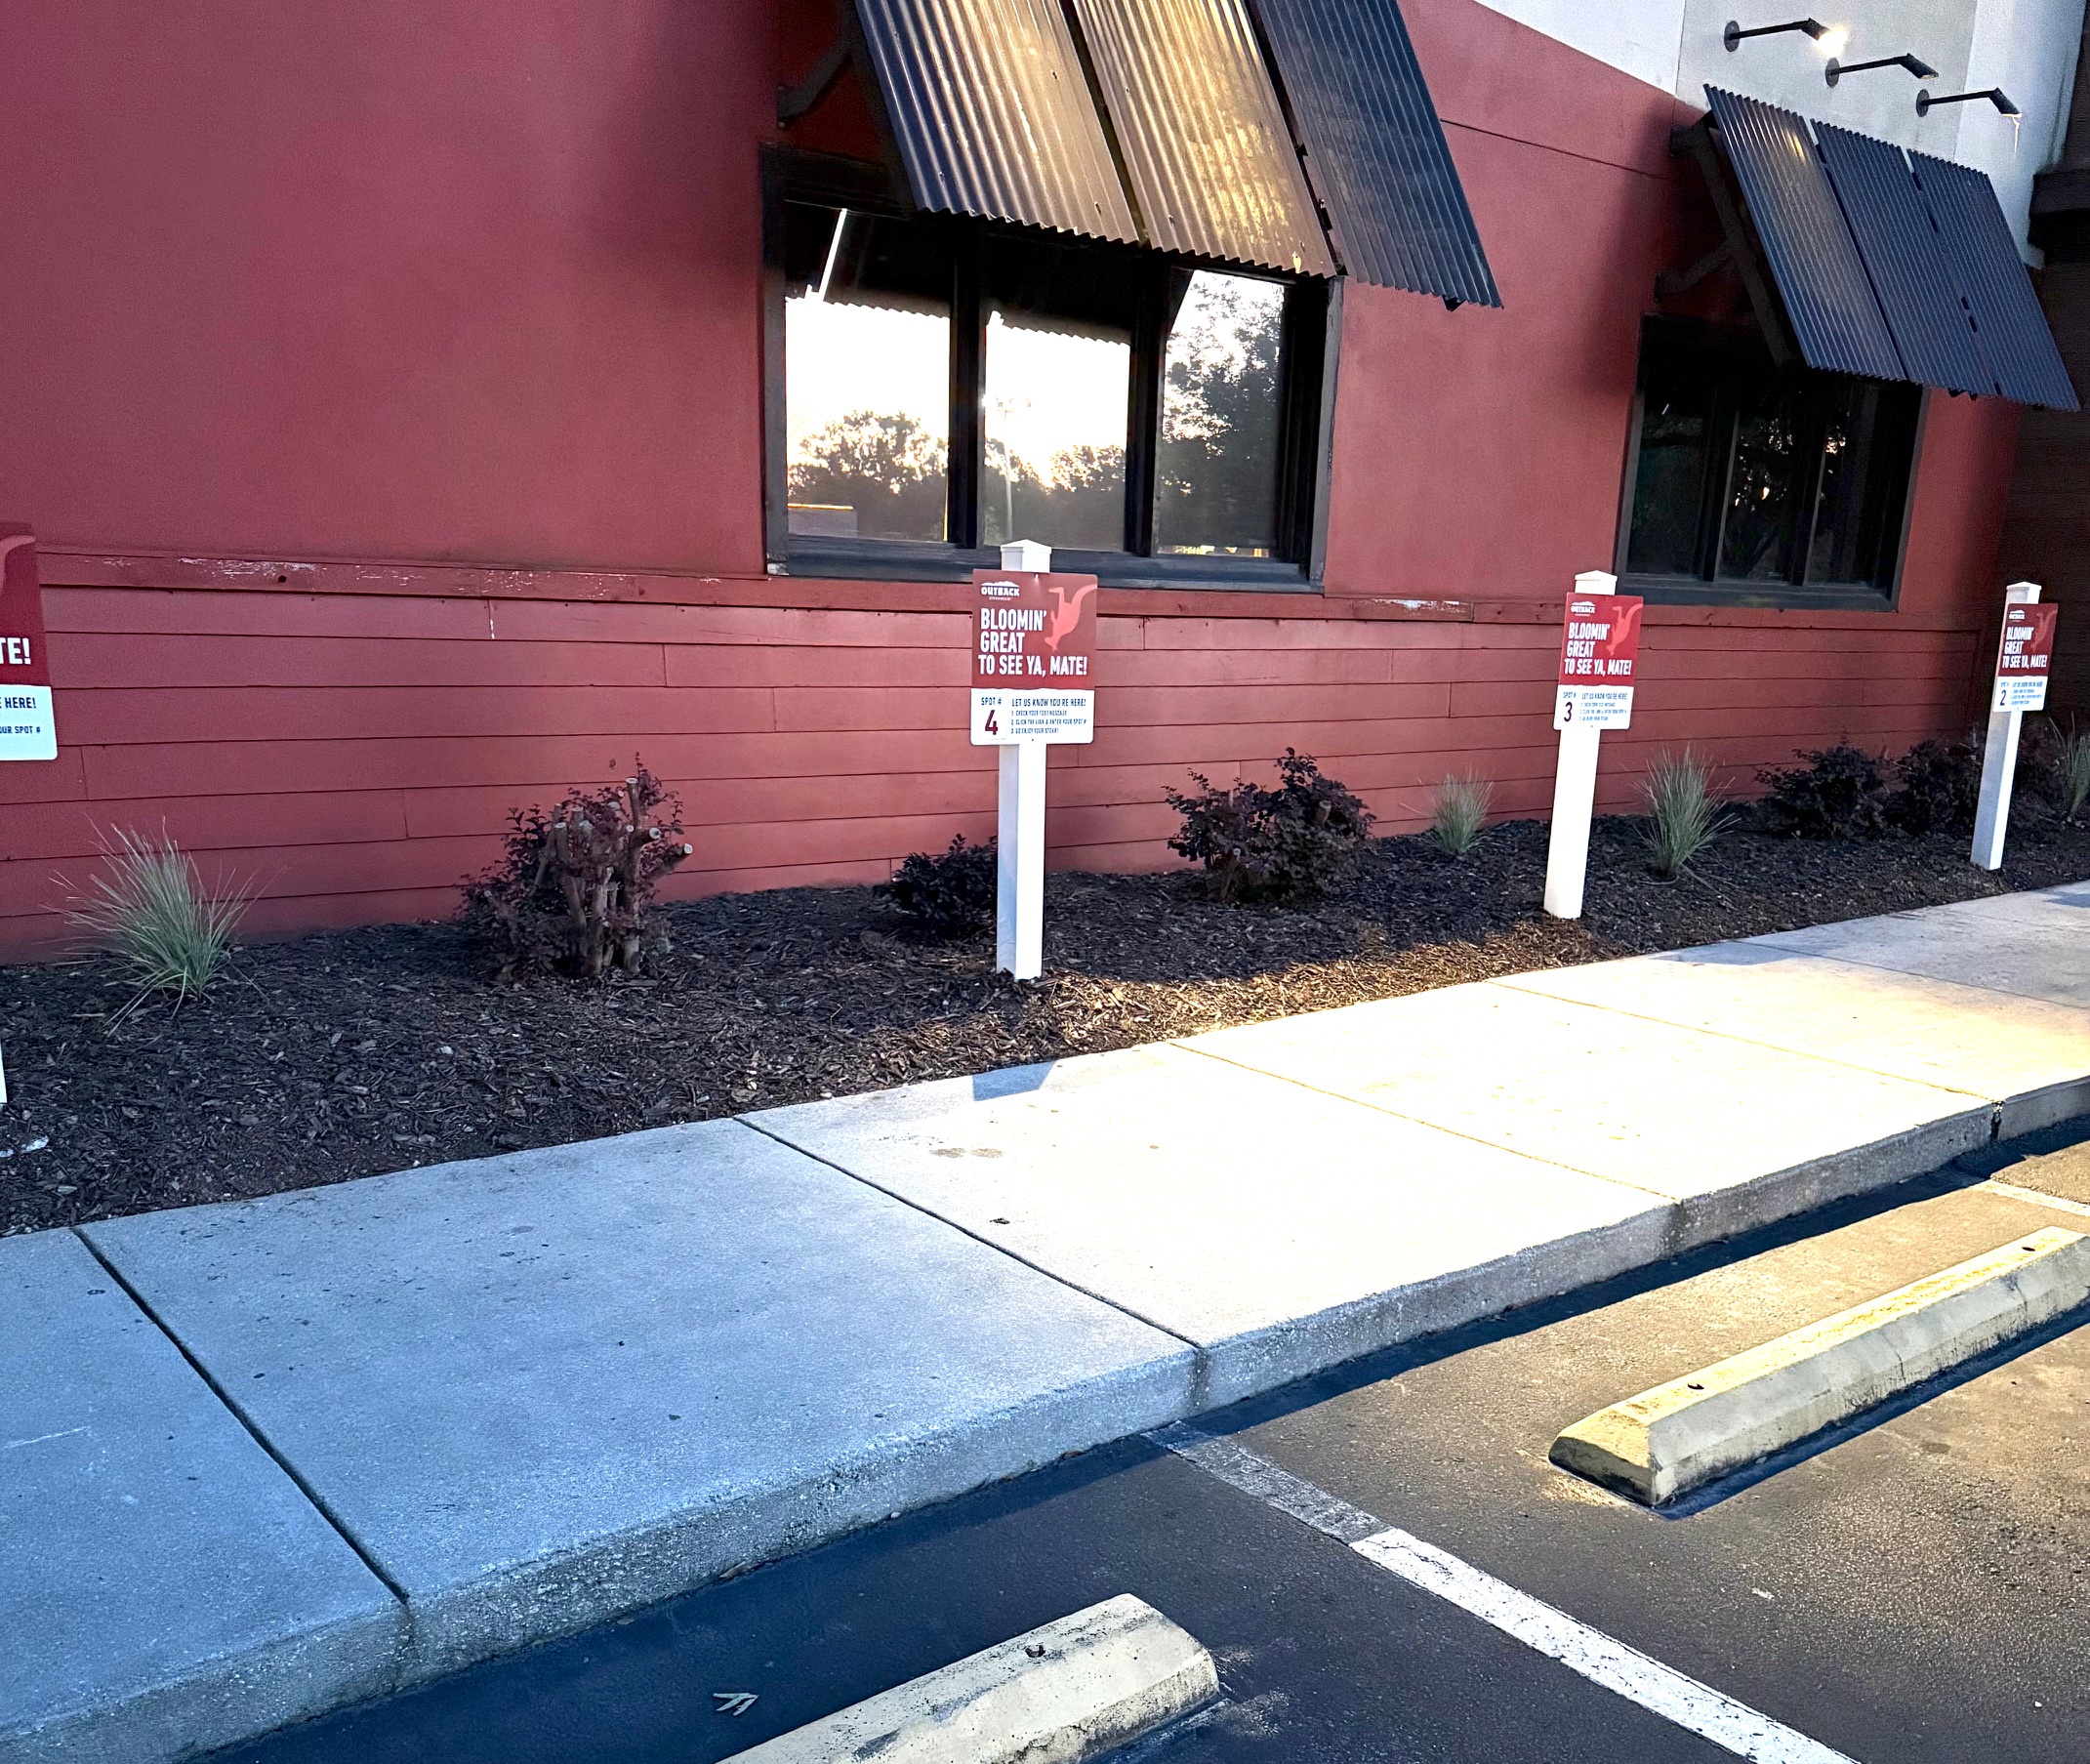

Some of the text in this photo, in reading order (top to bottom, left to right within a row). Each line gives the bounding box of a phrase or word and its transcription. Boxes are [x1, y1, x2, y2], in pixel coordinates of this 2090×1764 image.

[981, 587, 1020, 596] OUTBACK
[980, 608, 1047, 631] BLOOMIN'
[1568, 622, 1610, 640] BLOOMIN'
[980, 631, 1025, 653] GREAT
[1566, 640, 1596, 657] GREAT
[2004, 641, 2024, 654] GREAT
[978, 655, 1087, 677] TO SEE YA, MATE!
[1564, 658, 1632, 677] TO SEE YA, MATE!
[2010, 655, 2021, 668] SEE
[5, 697, 36, 709] HERE!
[981, 697, 995, 705] SPOT
[2000, 690, 2006, 706] 2
[1564, 701, 1573, 722] 3
[984, 710, 998, 735] 4
